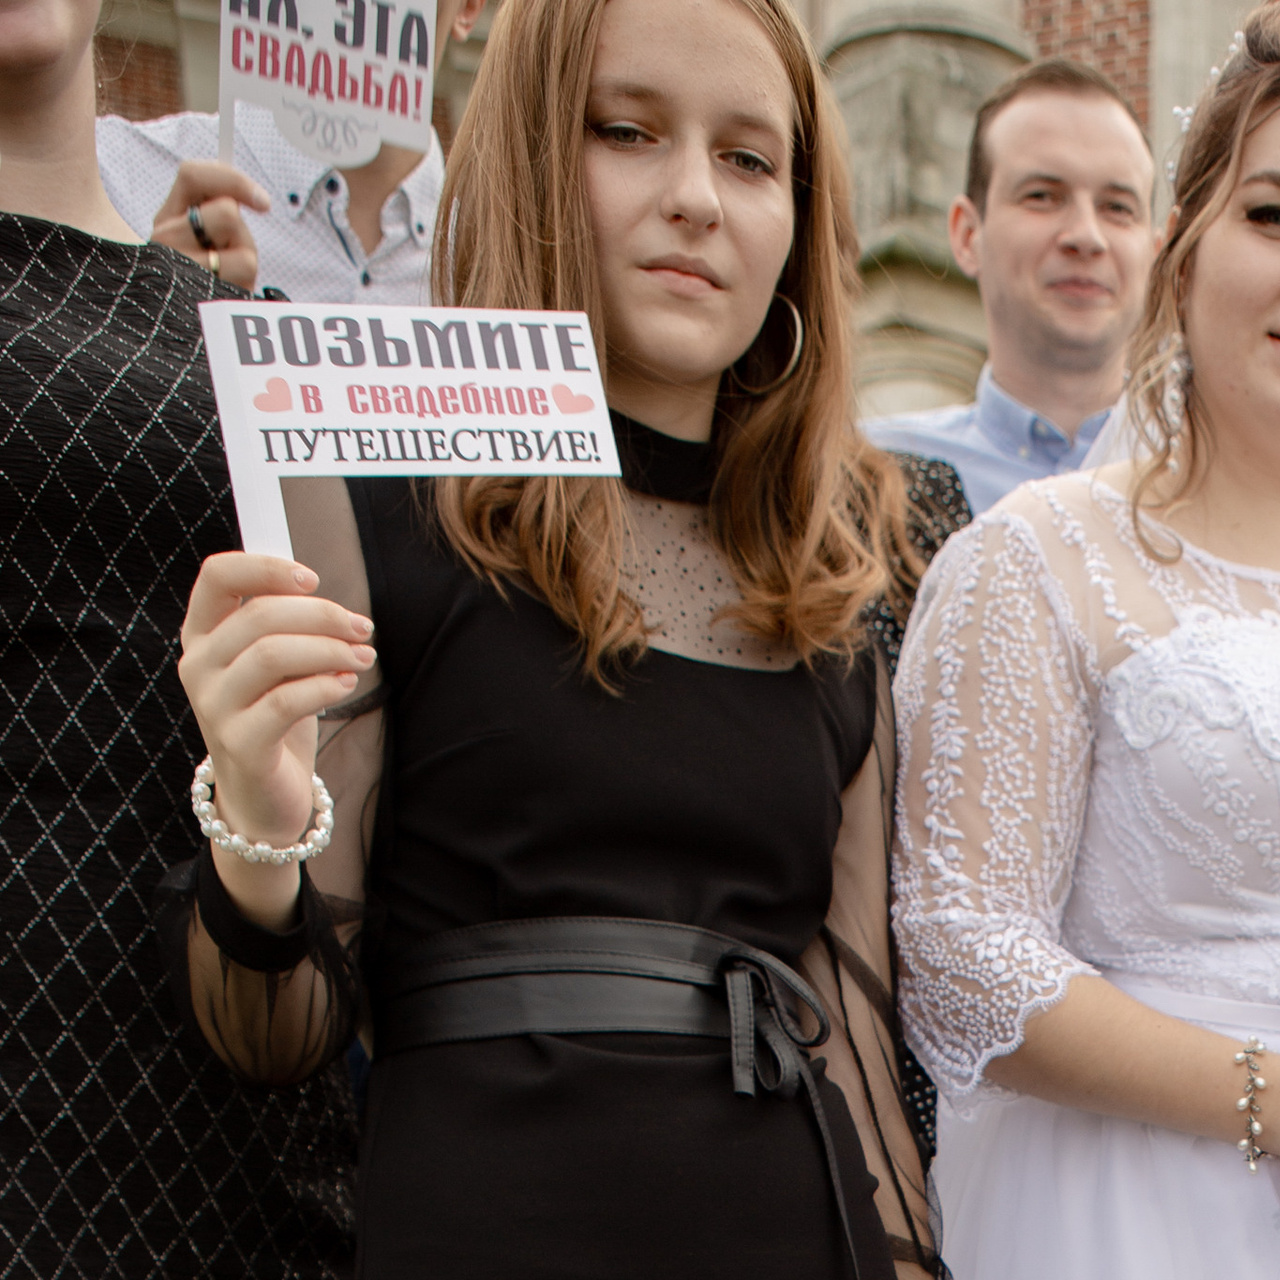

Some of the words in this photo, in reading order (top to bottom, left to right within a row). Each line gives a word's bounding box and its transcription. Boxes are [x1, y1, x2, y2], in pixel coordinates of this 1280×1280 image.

[334, 0, 429, 70] ЭТА
[231, 24, 424, 123] СВАДЬБА!
[231, 314, 592, 373] ВОЗЬМИТЕ
[299, 384, 324, 415] в
[346, 382, 550, 419] свадебное
[259, 427, 602, 464] ПУТЕШЕСТВИЕ!
